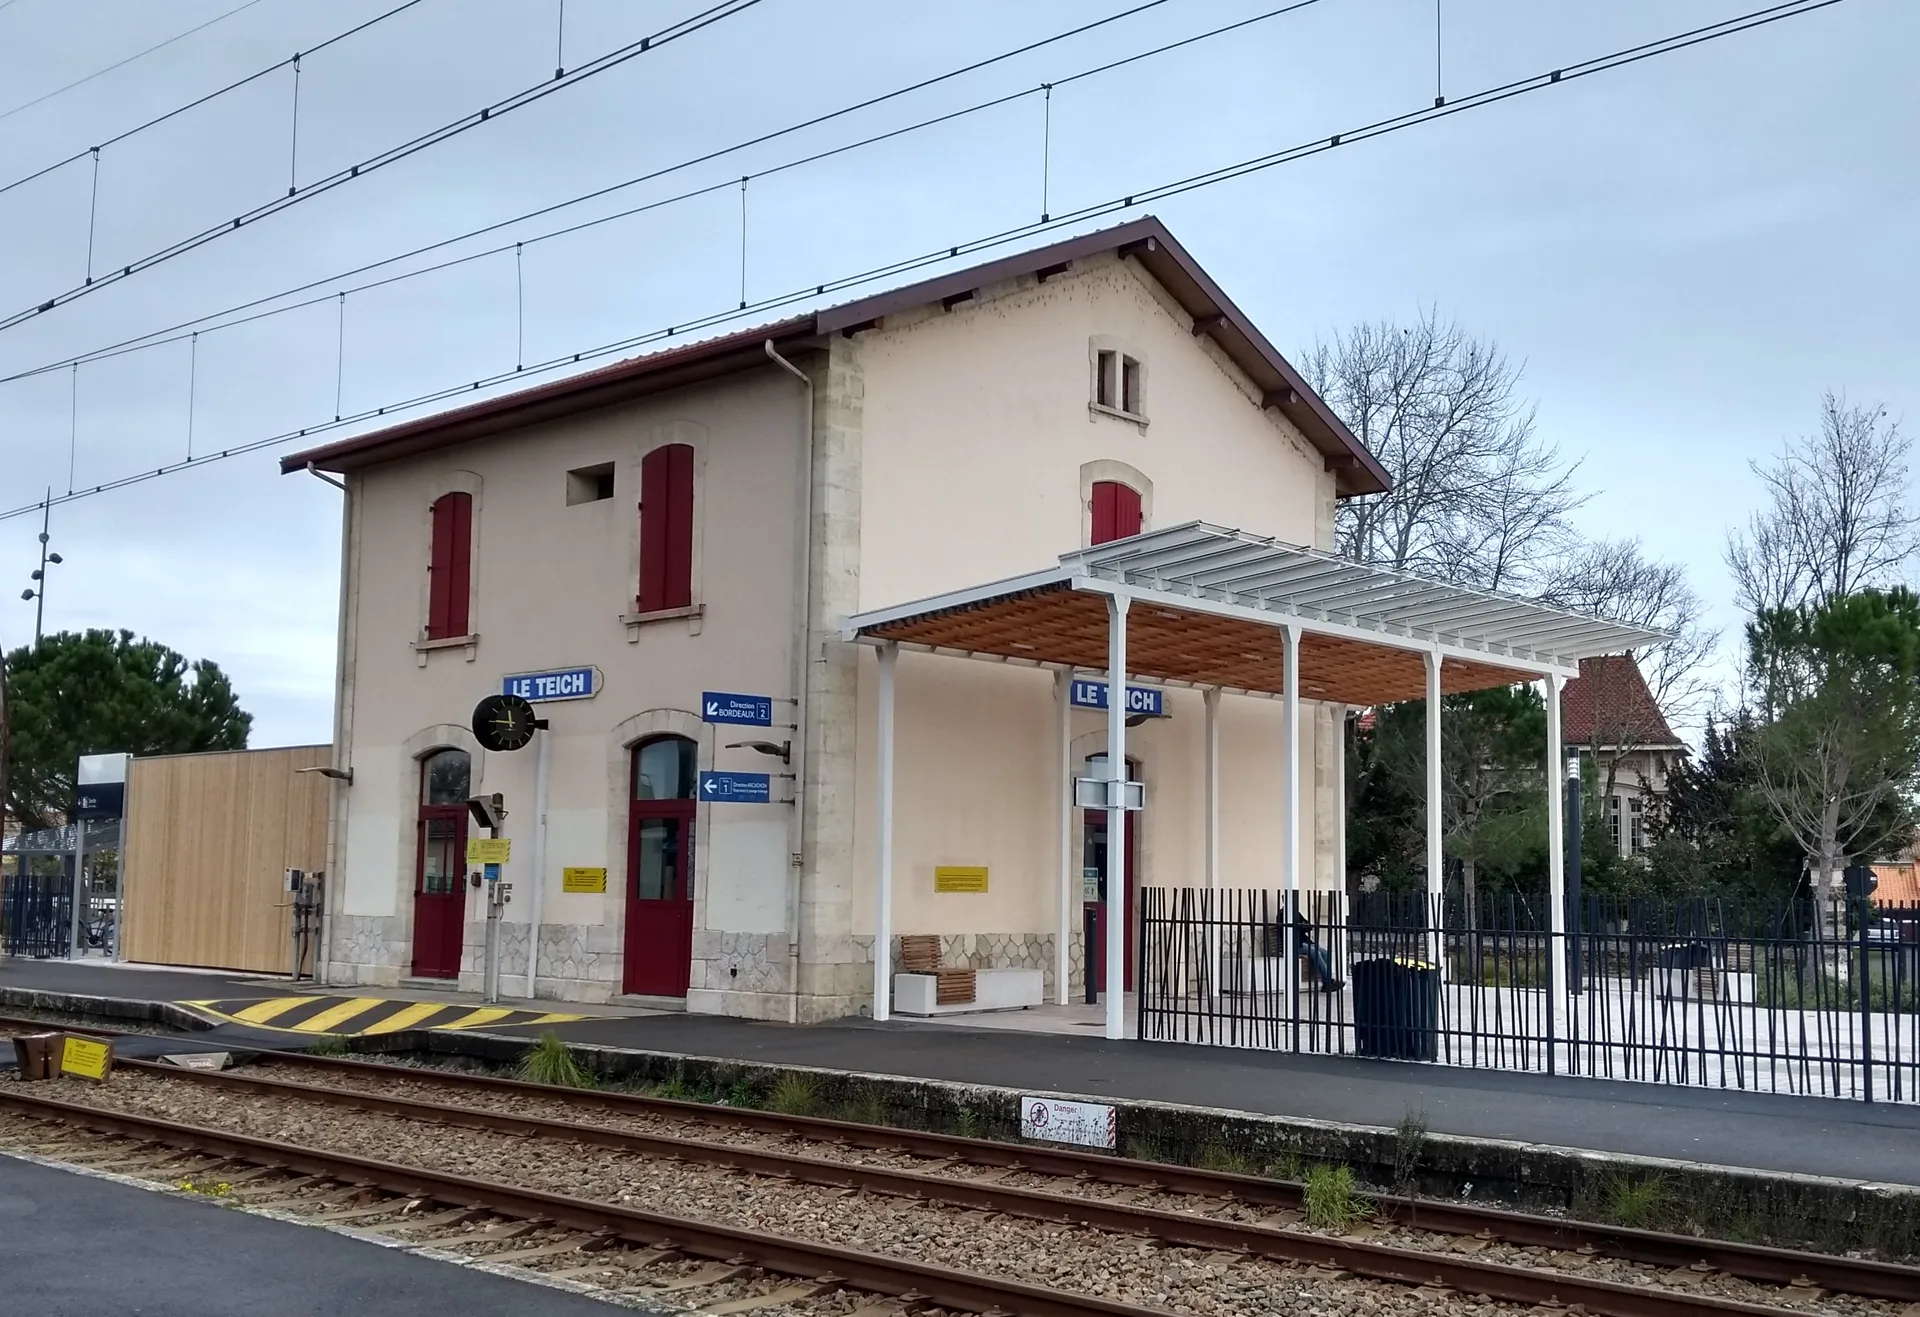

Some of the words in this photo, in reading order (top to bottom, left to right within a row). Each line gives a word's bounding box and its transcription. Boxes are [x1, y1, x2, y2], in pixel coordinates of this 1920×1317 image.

[513, 679, 530, 697] LE
[536, 674, 584, 696] TEICH
[1077, 684, 1098, 704] LE
[1104, 687, 1154, 710] TICH
[730, 700, 755, 710] Direction
[719, 709, 755, 718] BORDEAUX
[760, 709, 766, 718] 2
[723, 784, 728, 793] 1
[1053, 1103, 1078, 1115] Danger
